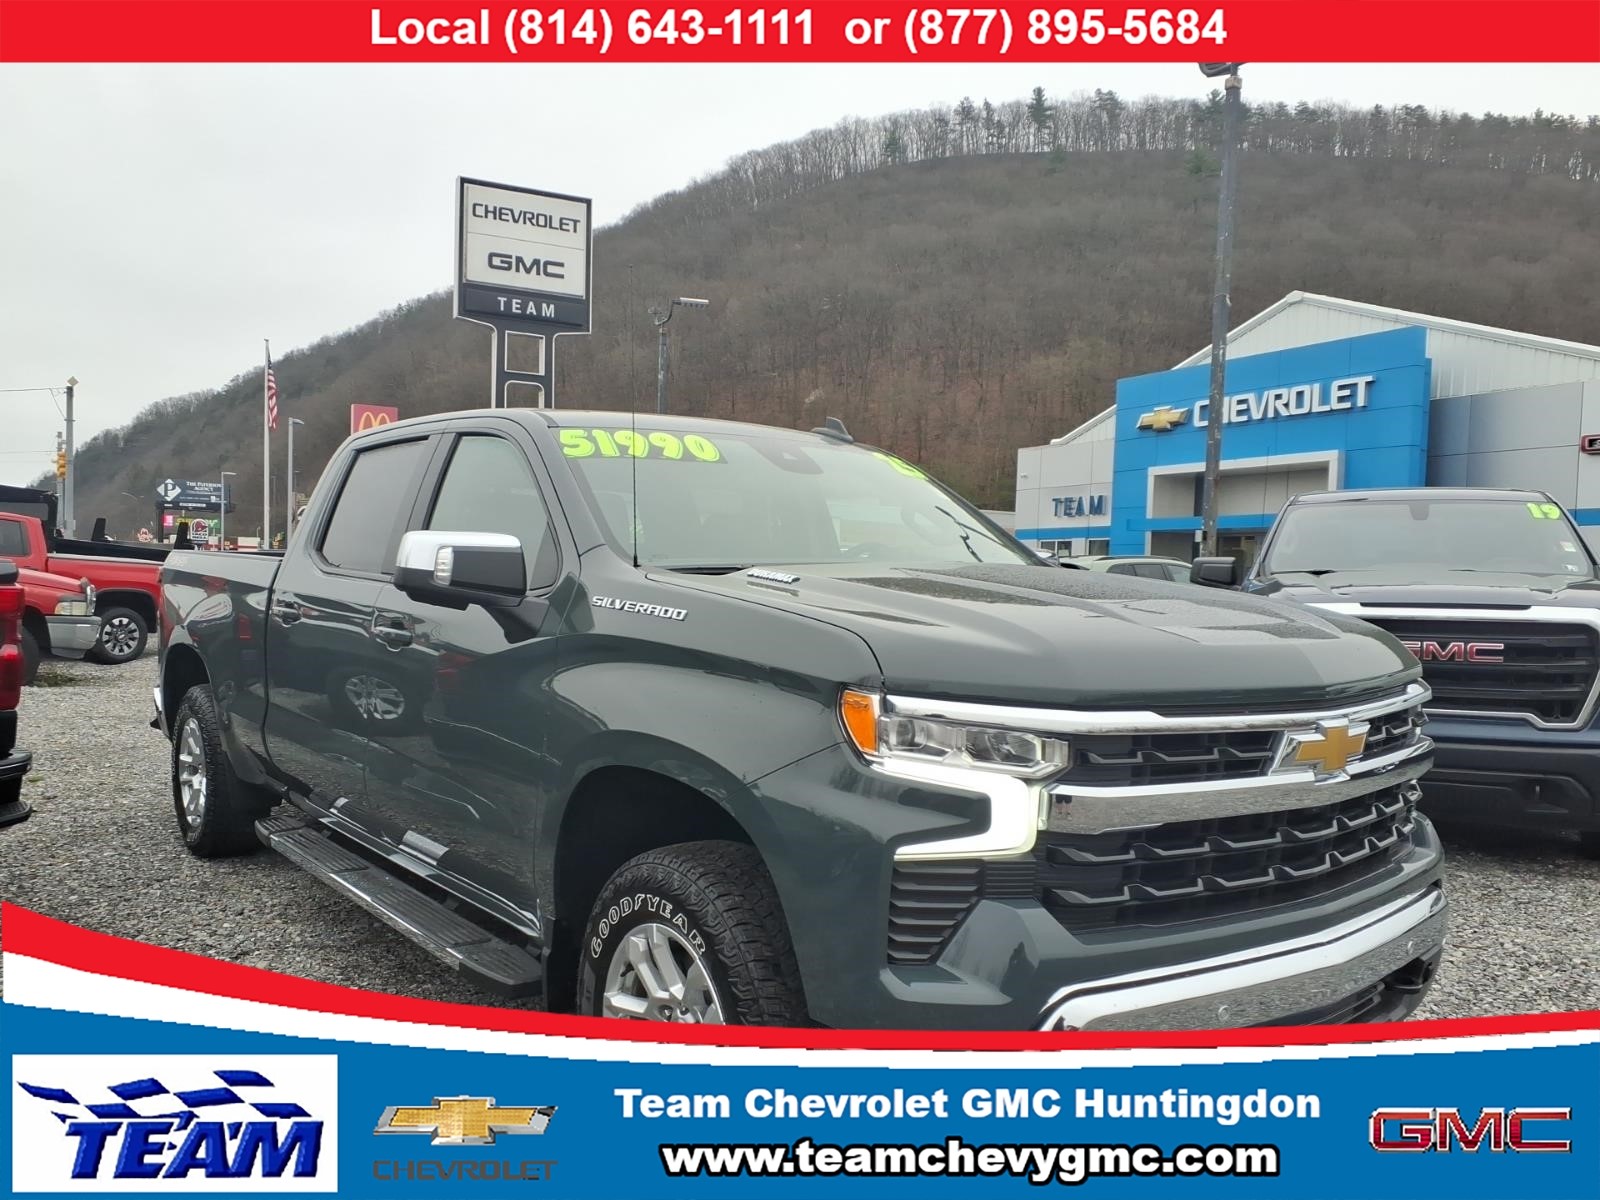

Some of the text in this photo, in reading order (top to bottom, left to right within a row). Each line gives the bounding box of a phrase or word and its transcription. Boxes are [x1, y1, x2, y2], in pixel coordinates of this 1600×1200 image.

[472, 203, 581, 233] CHEVROLET
[487, 252, 565, 279] GMC
[497, 297, 555, 318] TEAM
[559, 428, 722, 462] 51990
[1052, 494, 1107, 518] TEAM
[1526, 502, 1562, 519] 19
[592, 595, 690, 621] SILVERADO
[590, 893, 706, 958] GOODYEAR
